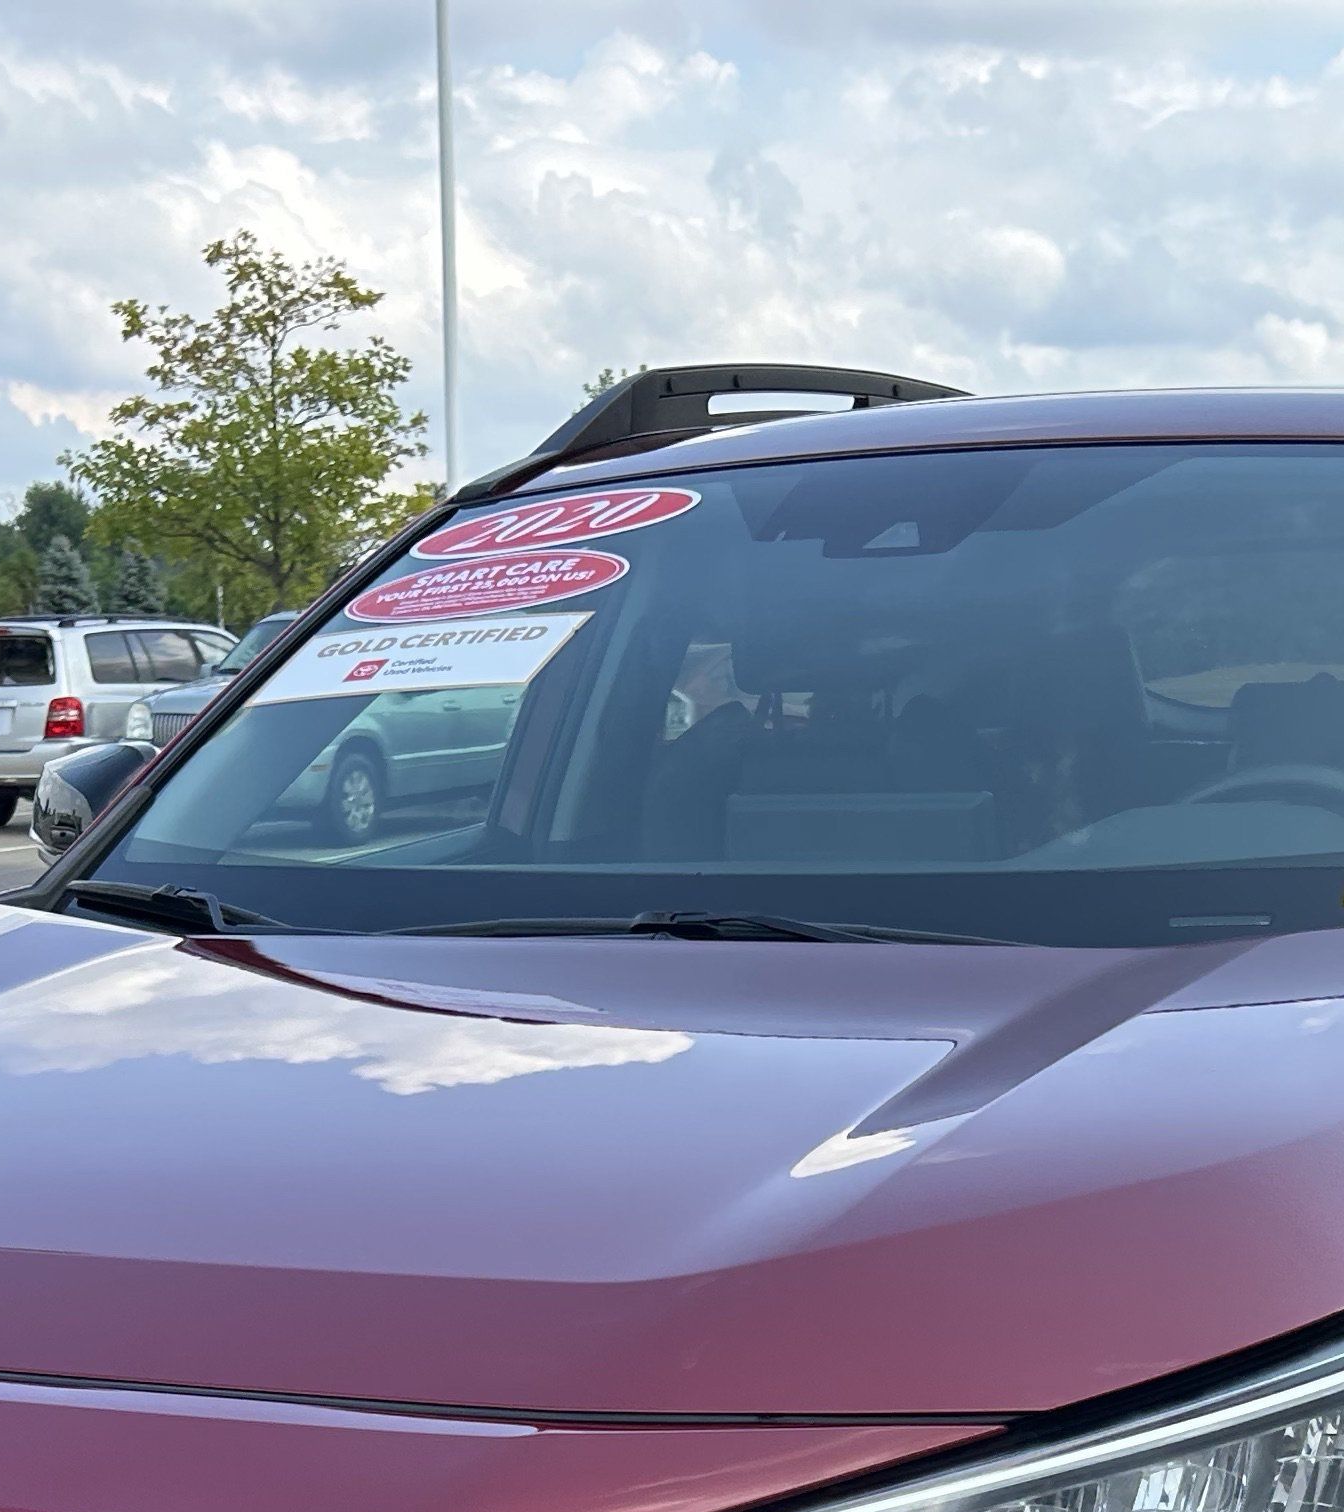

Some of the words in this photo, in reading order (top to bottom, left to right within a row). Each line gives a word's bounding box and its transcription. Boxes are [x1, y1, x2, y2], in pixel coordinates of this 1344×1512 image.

[441, 493, 661, 553] 2020
[376, 589, 423, 604] YOUR
[422, 582, 473, 597] FIRST
[531, 573, 562, 584] ON
[562, 570, 596, 581] US!
[411, 565, 507, 589] SMART
[506, 558, 581, 576] CARE
[317, 636, 398, 658] GOLD
[399, 625, 549, 650] CERTIFIED
[391, 657, 437, 667] Certified
